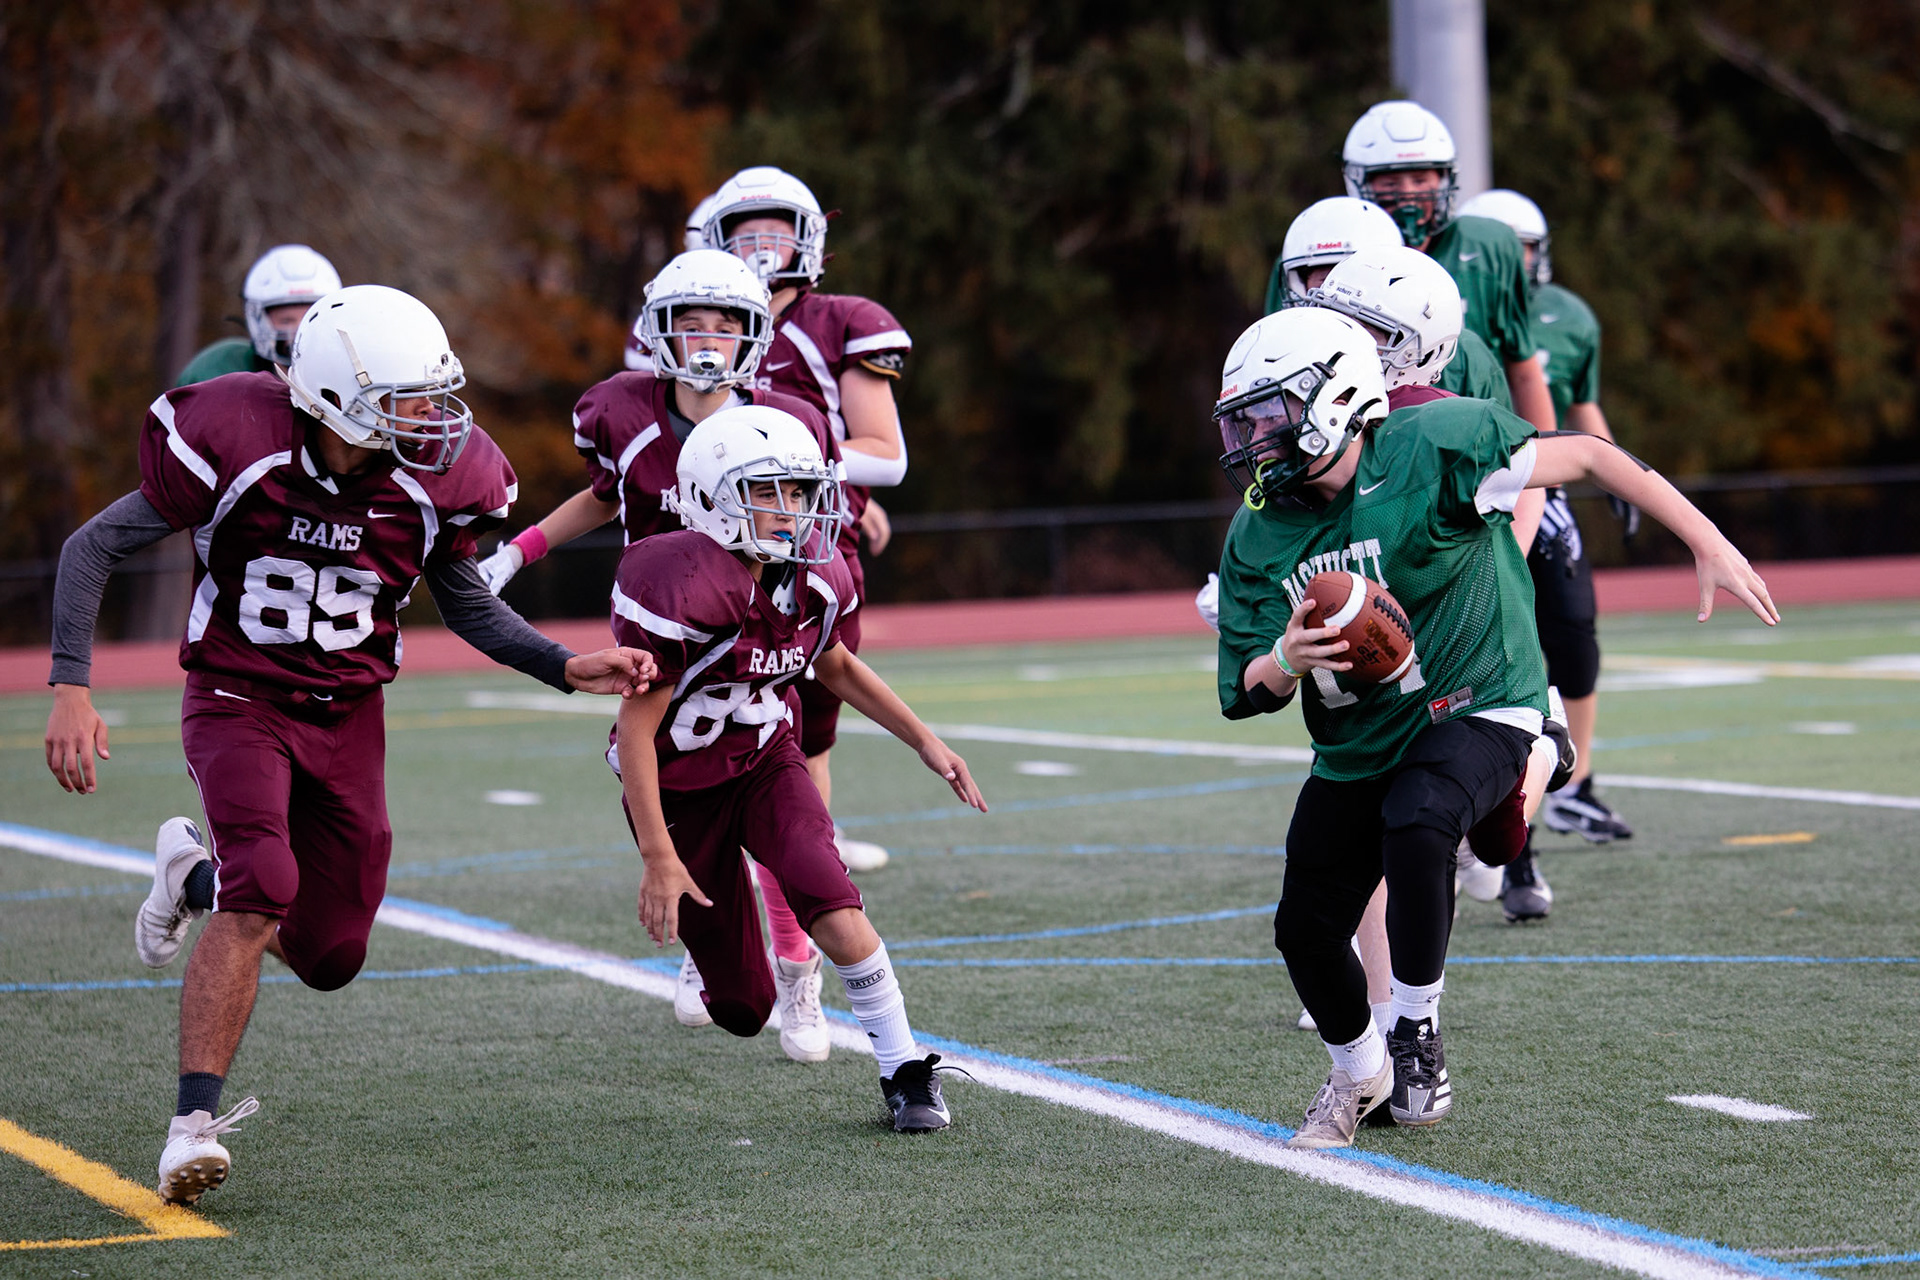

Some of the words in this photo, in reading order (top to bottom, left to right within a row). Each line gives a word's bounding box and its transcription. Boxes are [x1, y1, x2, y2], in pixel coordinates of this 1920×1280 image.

[287, 516, 363, 552] RAMS
[239, 555, 385, 652] 89
[749, 646, 805, 674] RAMS
[669, 672, 798, 751] 84
[849, 971, 882, 988] BATTLE
